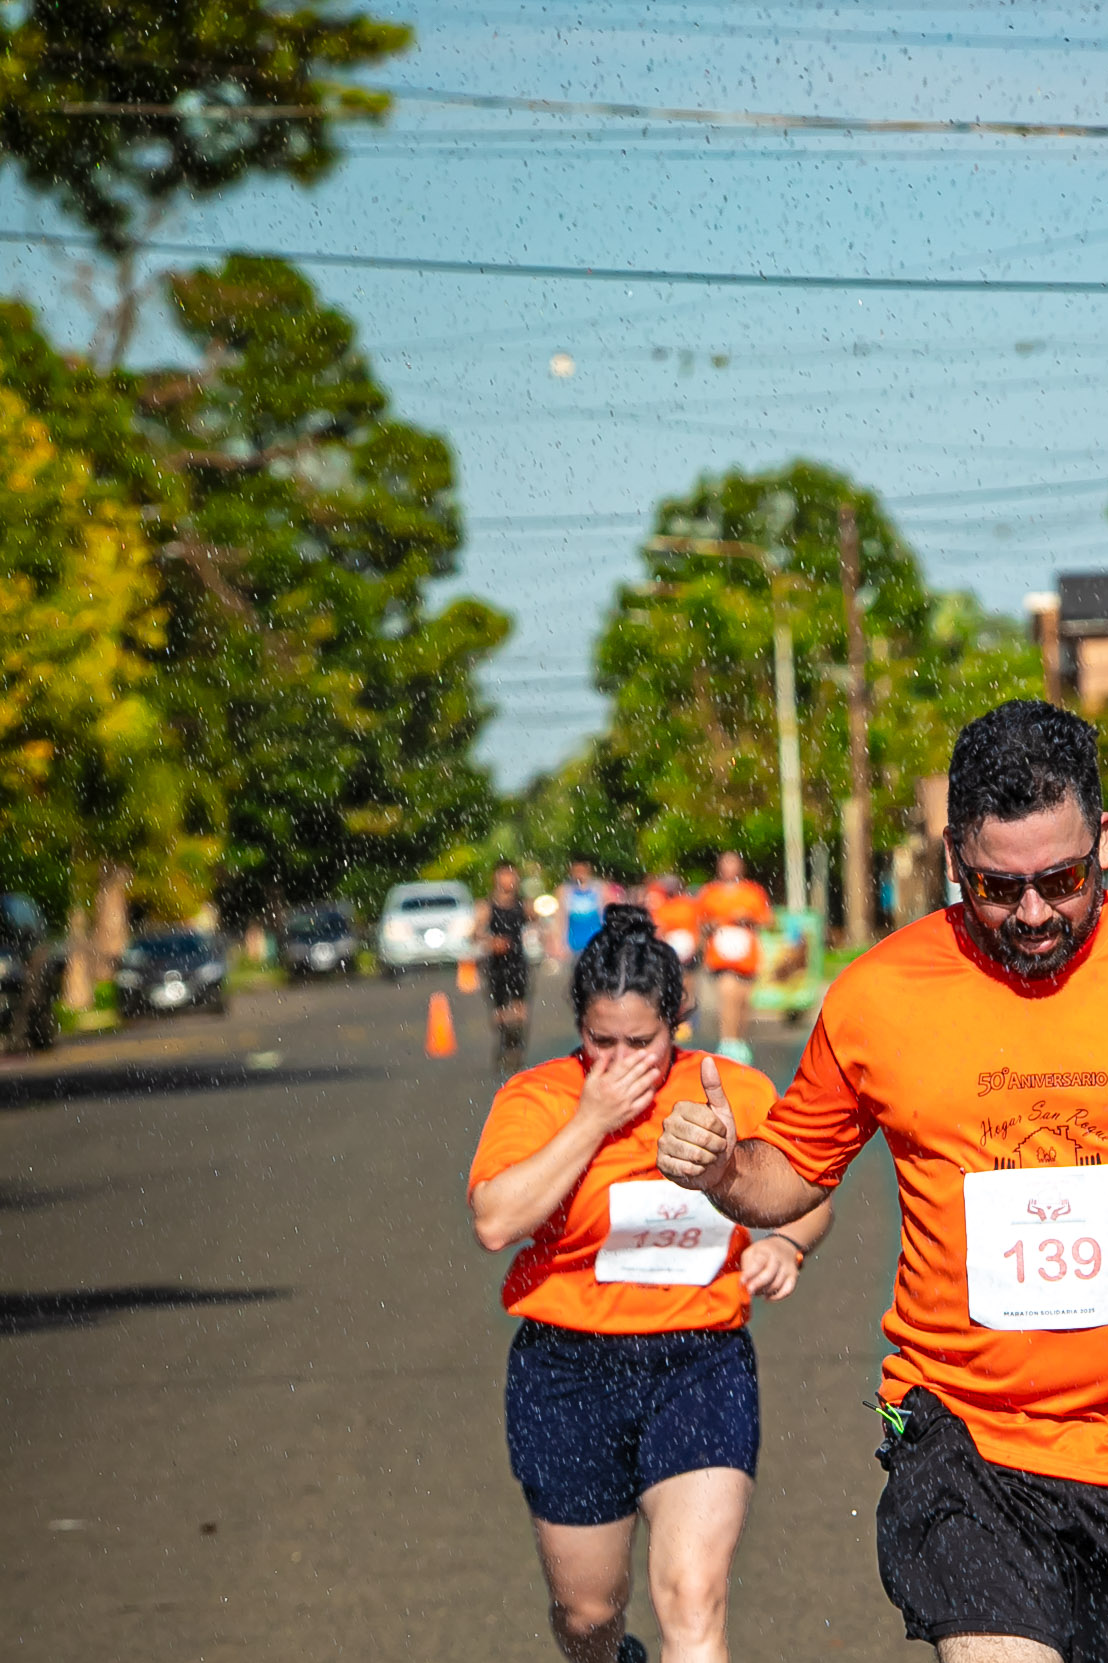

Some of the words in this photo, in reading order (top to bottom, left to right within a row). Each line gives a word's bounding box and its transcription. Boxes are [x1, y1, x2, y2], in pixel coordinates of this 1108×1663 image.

[1008, 1072, 1108, 1090] ANIVERSARIO
[980, 1115, 1022, 1147] Hogar
[1028, 1100, 1061, 1121] San
[632, 1227, 702, 1249] 138
[1003, 1237, 1102, 1283] 139
